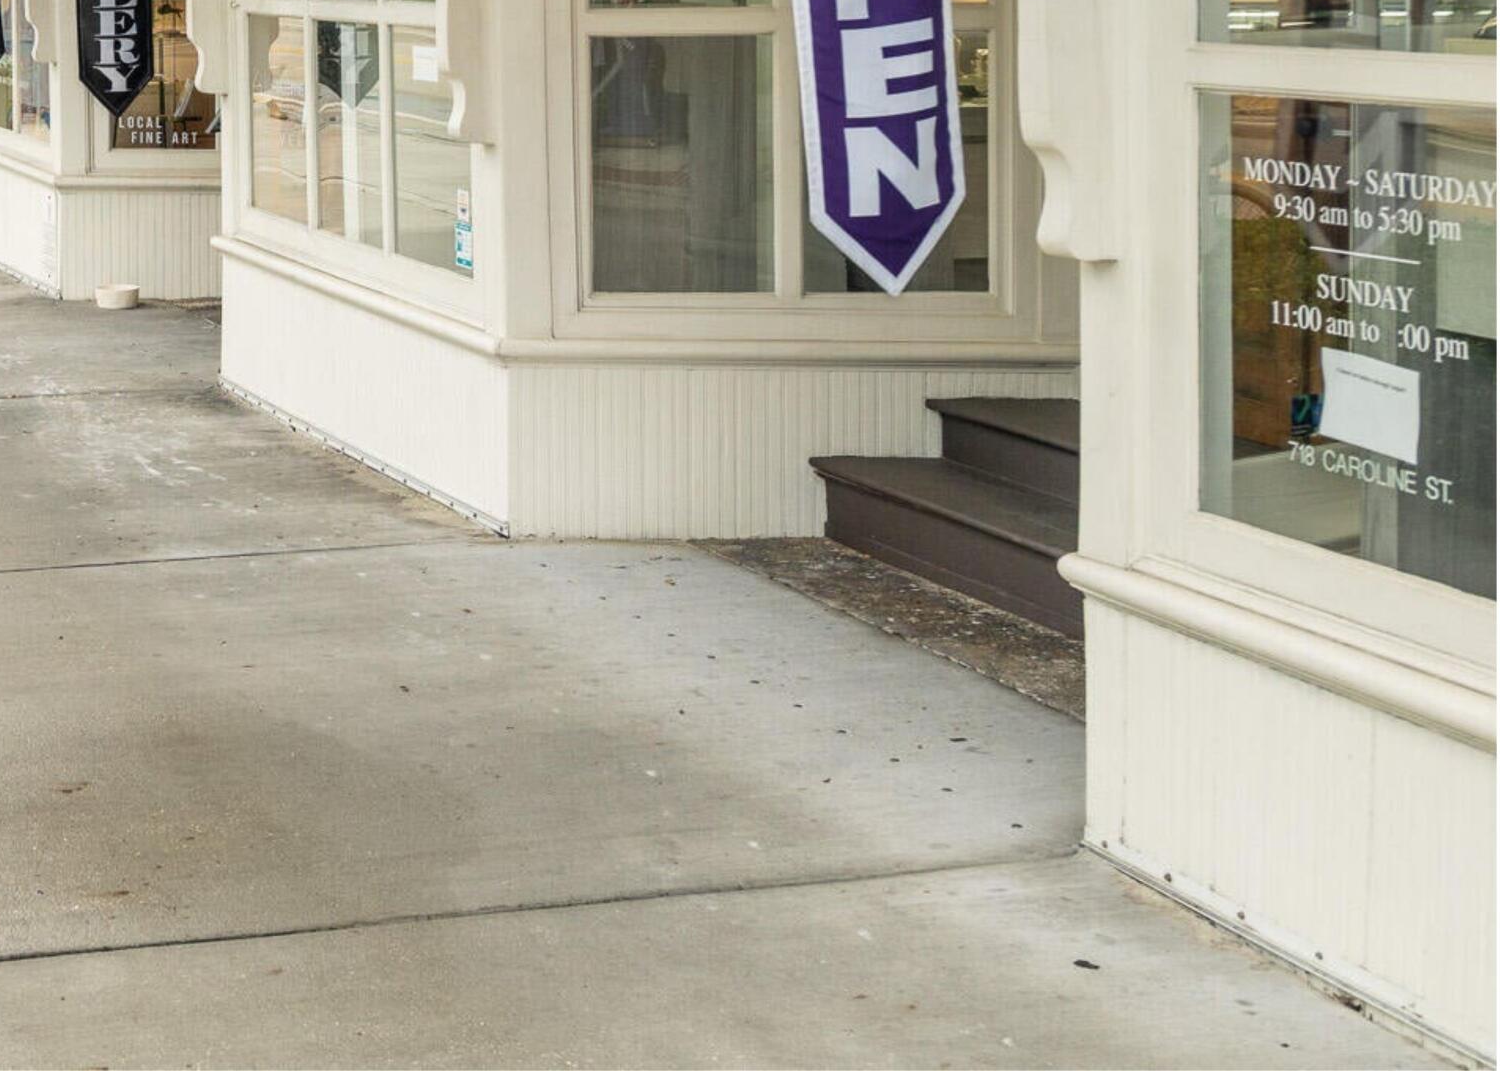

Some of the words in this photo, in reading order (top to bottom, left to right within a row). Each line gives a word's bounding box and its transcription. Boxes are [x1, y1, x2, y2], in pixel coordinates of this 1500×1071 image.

[118, 116, 163, 129] LOCAL
[131, 131, 163, 144] FINE
[172, 131, 199, 145] ART
[1242, 157, 1341, 190] MONDAY
[1365, 169, 1497, 208] SATURDAY
[1274, 193, 1315, 222] 9:30
[1319, 205, 1348, 226] am
[1353, 207, 1373, 228] to
[1378, 206, 1422, 236] 5:30
[1428, 219, 1462, 246] pm
[1316, 274, 1414, 313] SUNDAY
[1271, 300, 1322, 332] 11:00
[1326, 316, 1355, 339] am
[1360, 320, 1380, 343] to
[1434, 336, 1469, 363] pm
[1287, 440, 1316, 466] 718
[1322, 449, 1418, 495] CAROLINE
[1425, 476, 1454, 504] ST.
